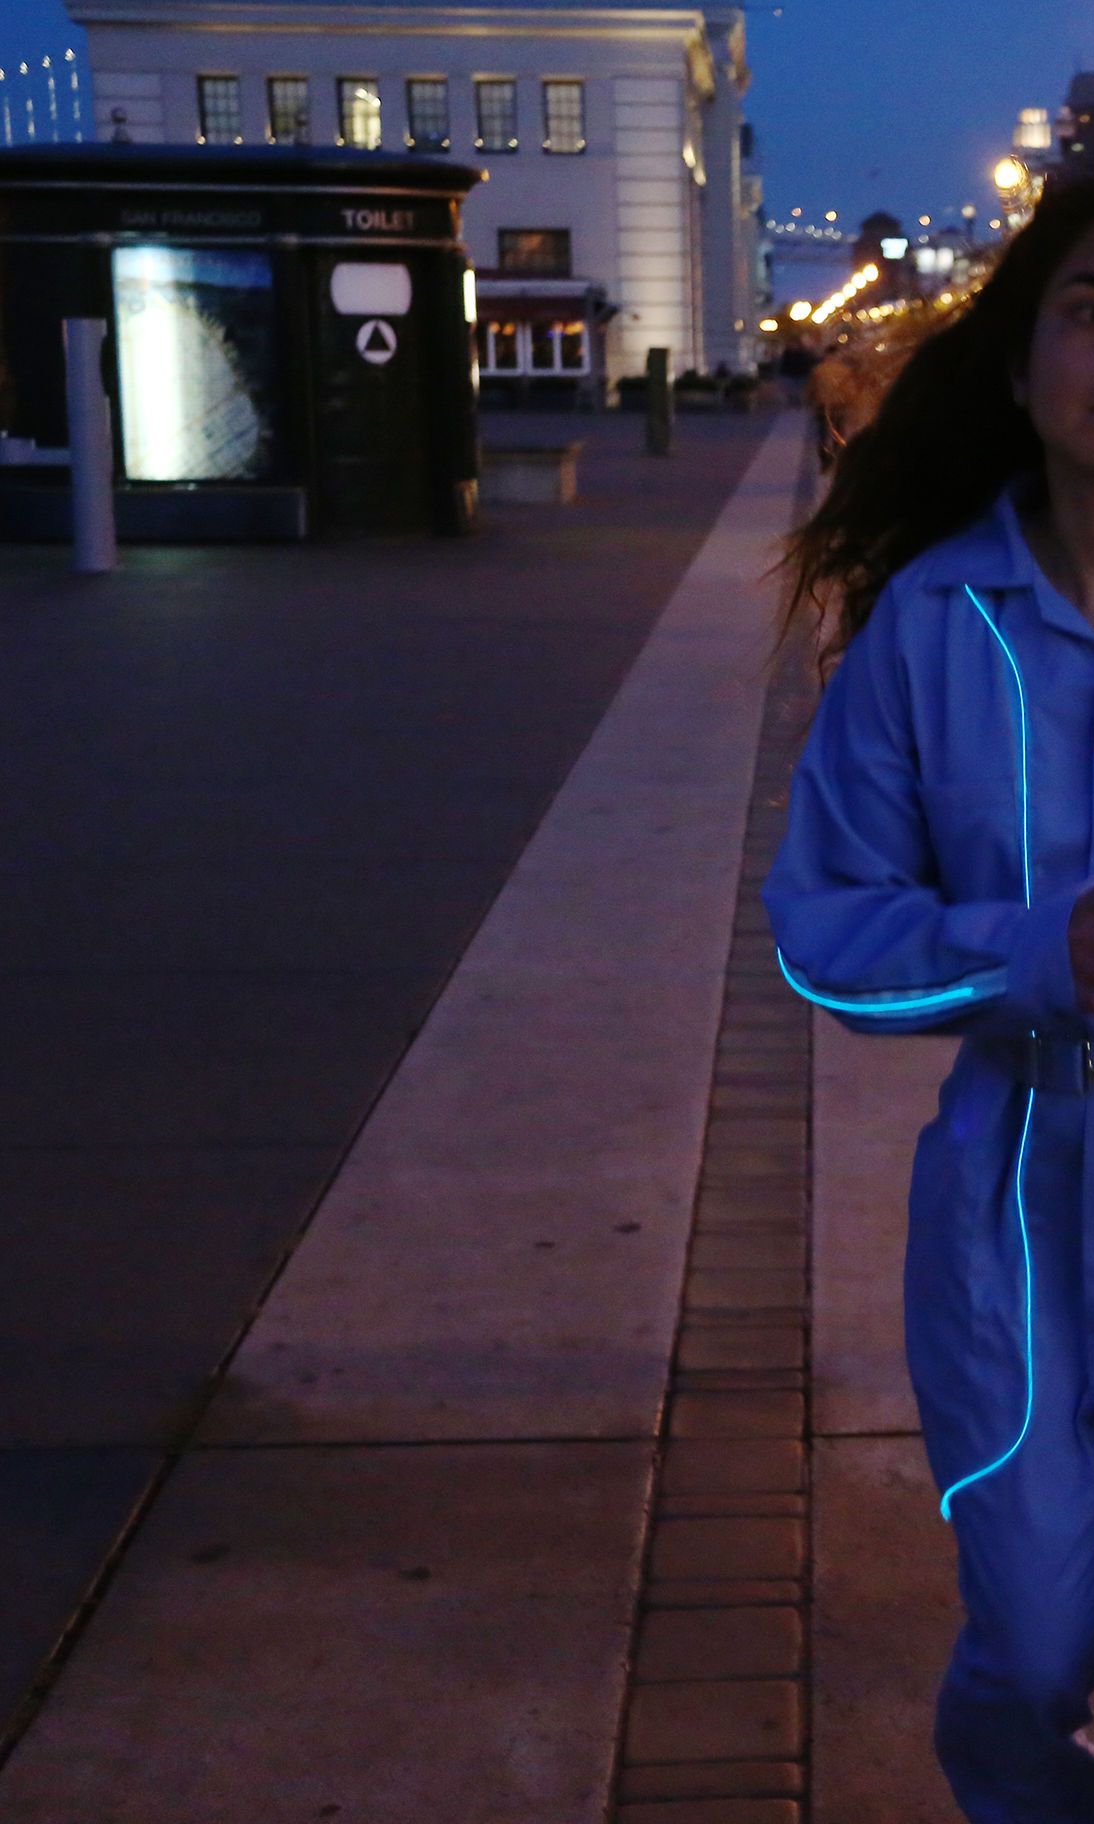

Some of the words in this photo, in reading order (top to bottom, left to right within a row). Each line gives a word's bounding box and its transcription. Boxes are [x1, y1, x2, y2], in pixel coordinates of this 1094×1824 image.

[121, 209, 158, 225] SAN
[162, 210, 262, 226] FRANCISCO
[341, 208, 416, 231] TOILET
